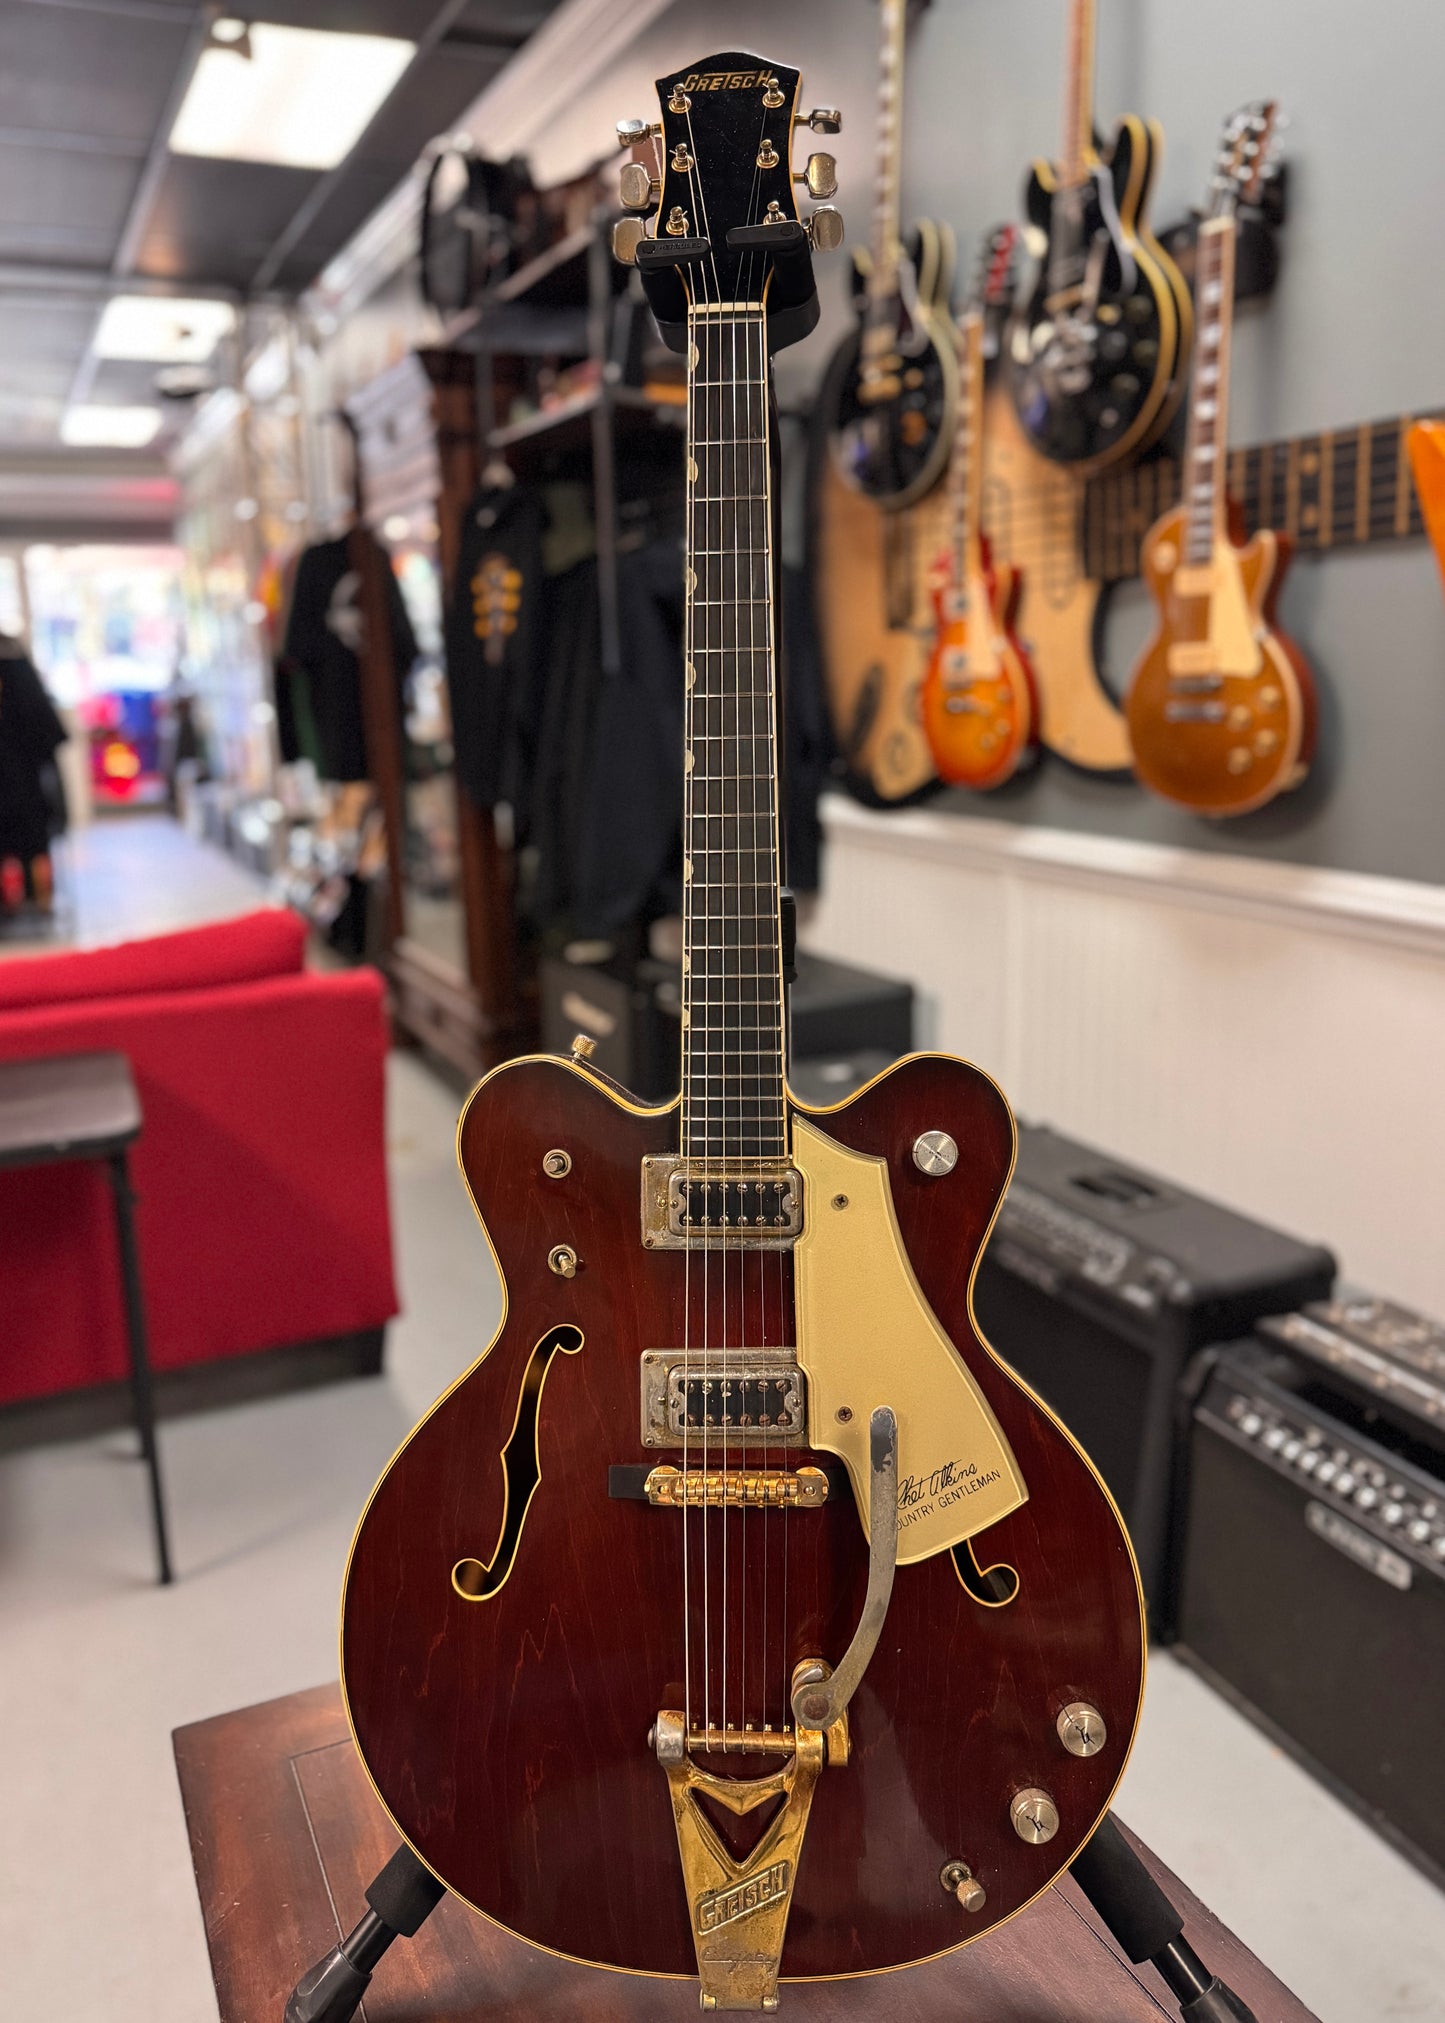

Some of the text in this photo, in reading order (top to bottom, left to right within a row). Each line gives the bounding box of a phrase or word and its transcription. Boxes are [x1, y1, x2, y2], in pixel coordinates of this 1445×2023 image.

[683, 69, 773, 92] GRETSCH
[896, 1470, 1001, 1531] OUNTRY GENTLEMAN
[700, 1863, 786, 1929] GRETSCH
